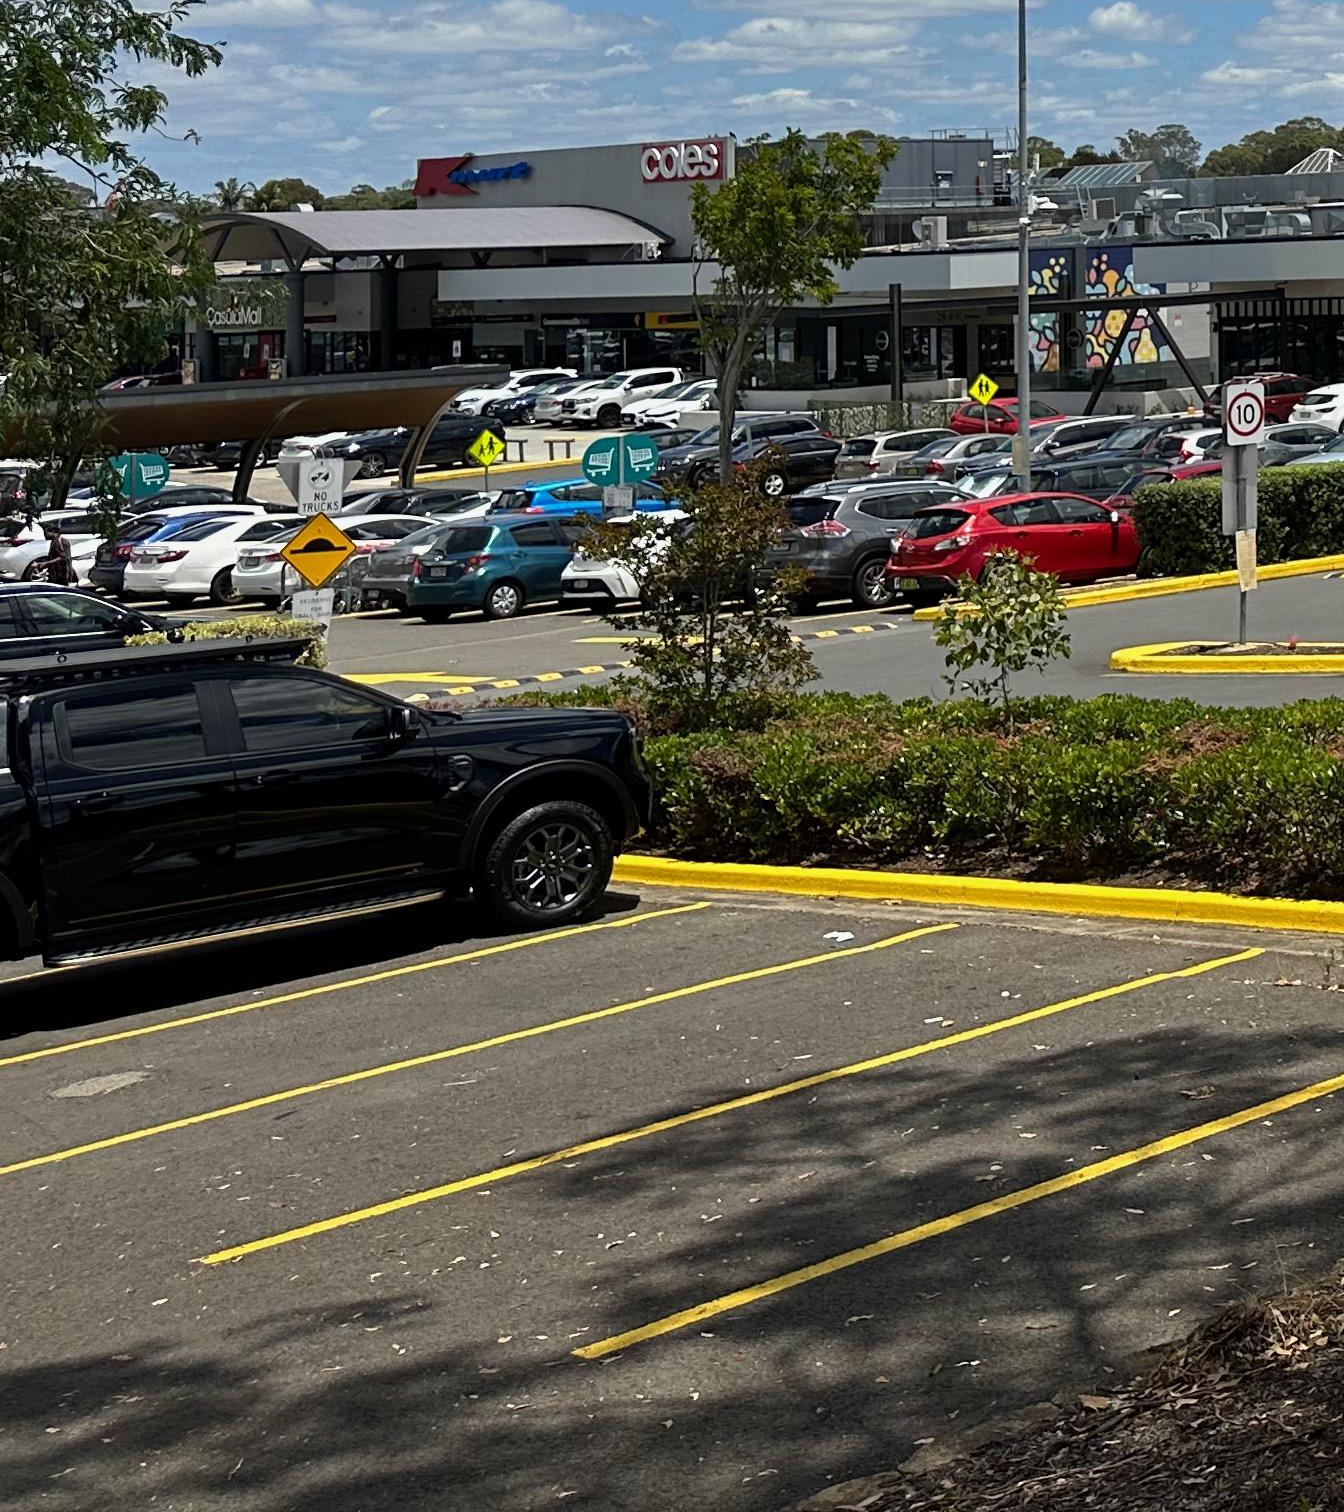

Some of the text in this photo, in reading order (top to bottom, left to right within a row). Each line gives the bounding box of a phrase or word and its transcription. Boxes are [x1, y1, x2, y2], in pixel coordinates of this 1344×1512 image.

[640, 143, 719, 180] coles
[1236, 403, 1256, 425] 10
[313, 491, 327, 501] NO
[302, 501, 339, 512] TRUCKS
